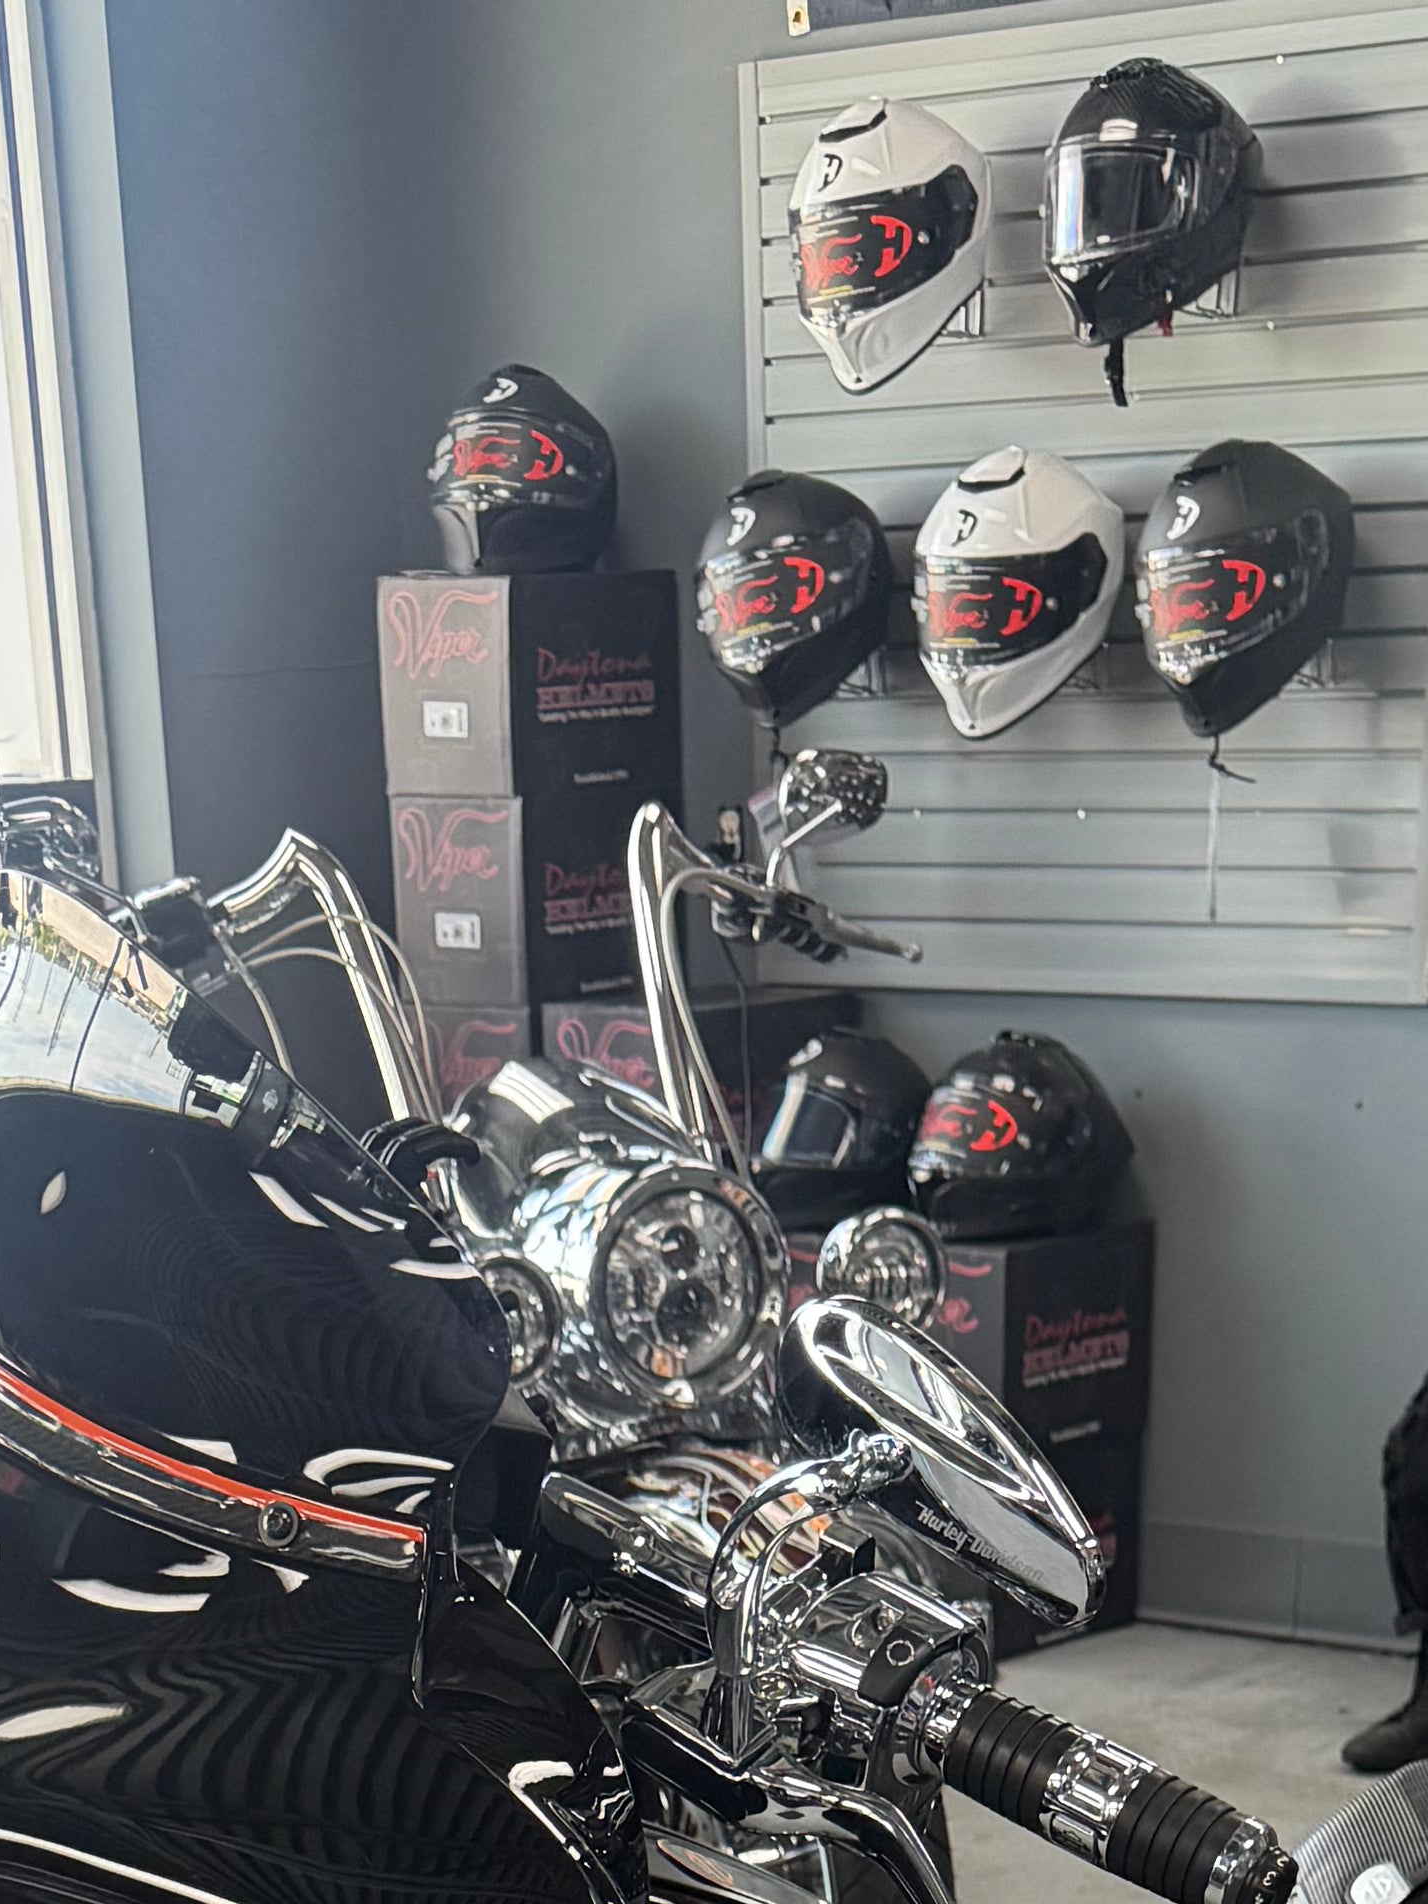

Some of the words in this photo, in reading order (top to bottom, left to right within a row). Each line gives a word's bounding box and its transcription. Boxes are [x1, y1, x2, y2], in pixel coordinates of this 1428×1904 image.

[537, 646, 650, 684] Daytona
[915, 1500, 1048, 1581] Harley-Davidson
[1263, 1871, 1276, 1886] 3
